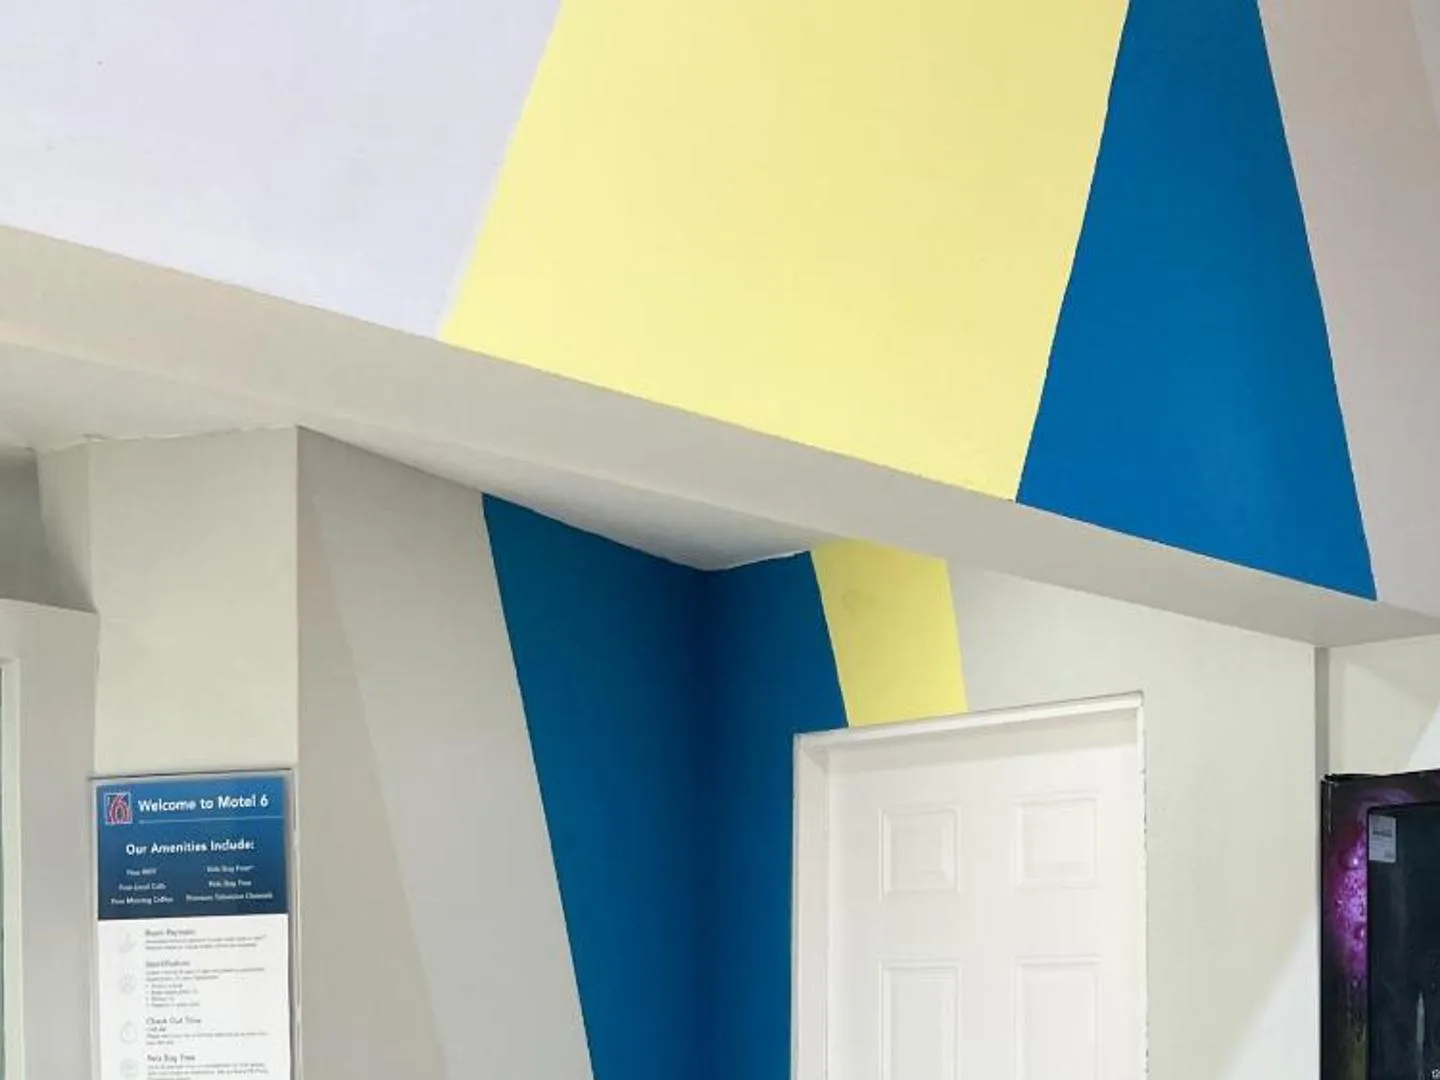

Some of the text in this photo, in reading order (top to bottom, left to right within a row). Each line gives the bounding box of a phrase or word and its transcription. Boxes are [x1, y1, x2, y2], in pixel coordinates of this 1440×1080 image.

[138, 794, 269, 813] Welcome to Motel 6
[126, 838, 255, 855] Our Amenities Include:
